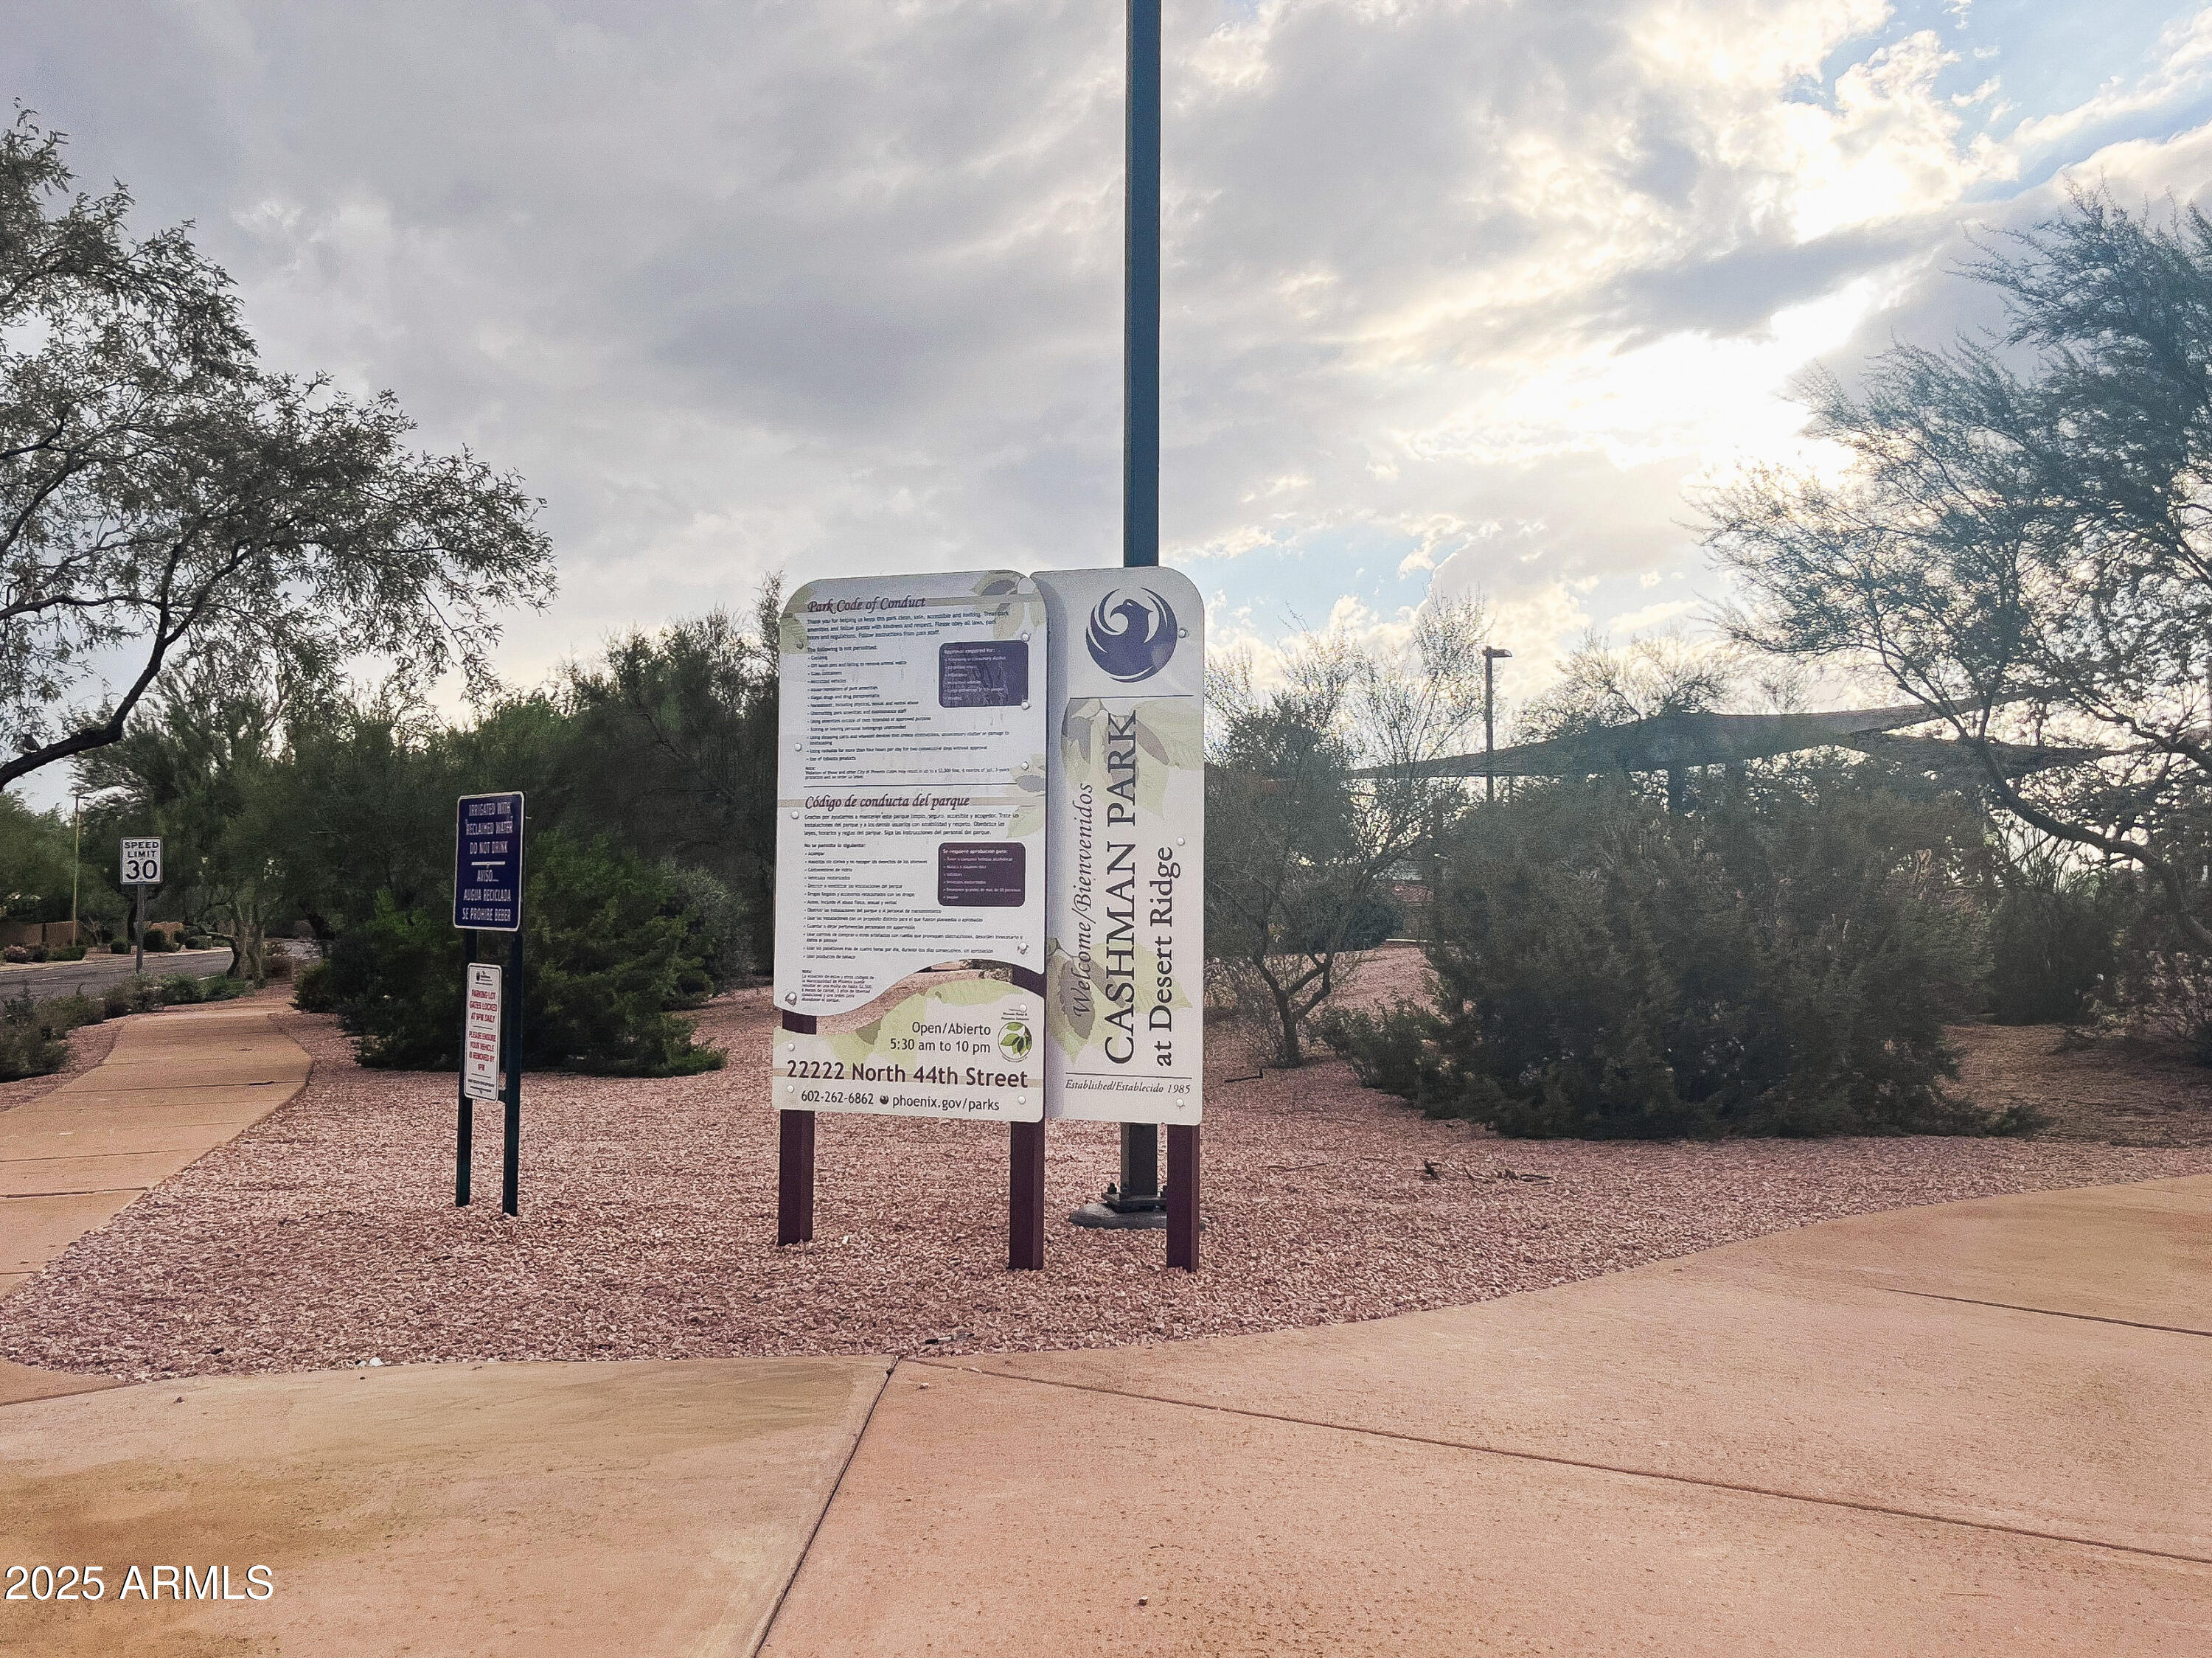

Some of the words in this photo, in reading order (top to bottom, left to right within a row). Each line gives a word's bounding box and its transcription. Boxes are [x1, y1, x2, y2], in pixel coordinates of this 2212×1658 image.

[807, 599, 836, 614] Park
[837, 597, 863, 612] Code
[866, 596, 880, 613] of
[880, 595, 926, 610] Conduct
[1107, 710, 1137, 827] PARK
[805, 795, 841, 811] Código
[844, 794, 858, 807] de
[860, 793, 909, 807] conducta
[912, 793, 931, 807] del
[930, 797, 970, 810] parque
[470, 843, 478, 854] DO
[480, 841, 490, 854] NOT
[492, 841, 508, 854] DRINK
[125, 860, 158, 879] 30
[1150, 846, 1181, 927] Ridge
[1071, 783, 1096, 1017] Welcome/Bienvenidos
[462, 908, 469, 920] SE
[1105, 840, 1136, 1065] CASHMAN
[1150, 936, 1173, 1032] Desert
[912, 1021, 991, 1036] Open/Abierto
[890, 1038, 915, 1051] 5:30
[918, 1041, 936, 1051] am
[939, 1040, 952, 1052] to
[956, 1040, 969, 1053] 10
[973, 1042, 991, 1056] pm
[1154, 1040, 1172, 1067] at
[787, 1060, 844, 1080] 22222
[852, 1062, 906, 1083] North
[914, 1065, 959, 1085] 44th
[966, 1067, 1028, 1088] Street
[1065, 1079, 1164, 1093] Established/Establecido
[1167, 1083, 1191, 1095] 1985
[801, 1090, 874, 1105] 602-262-6862
[892, 1094, 1000, 1111] phoenix.gov/parks
